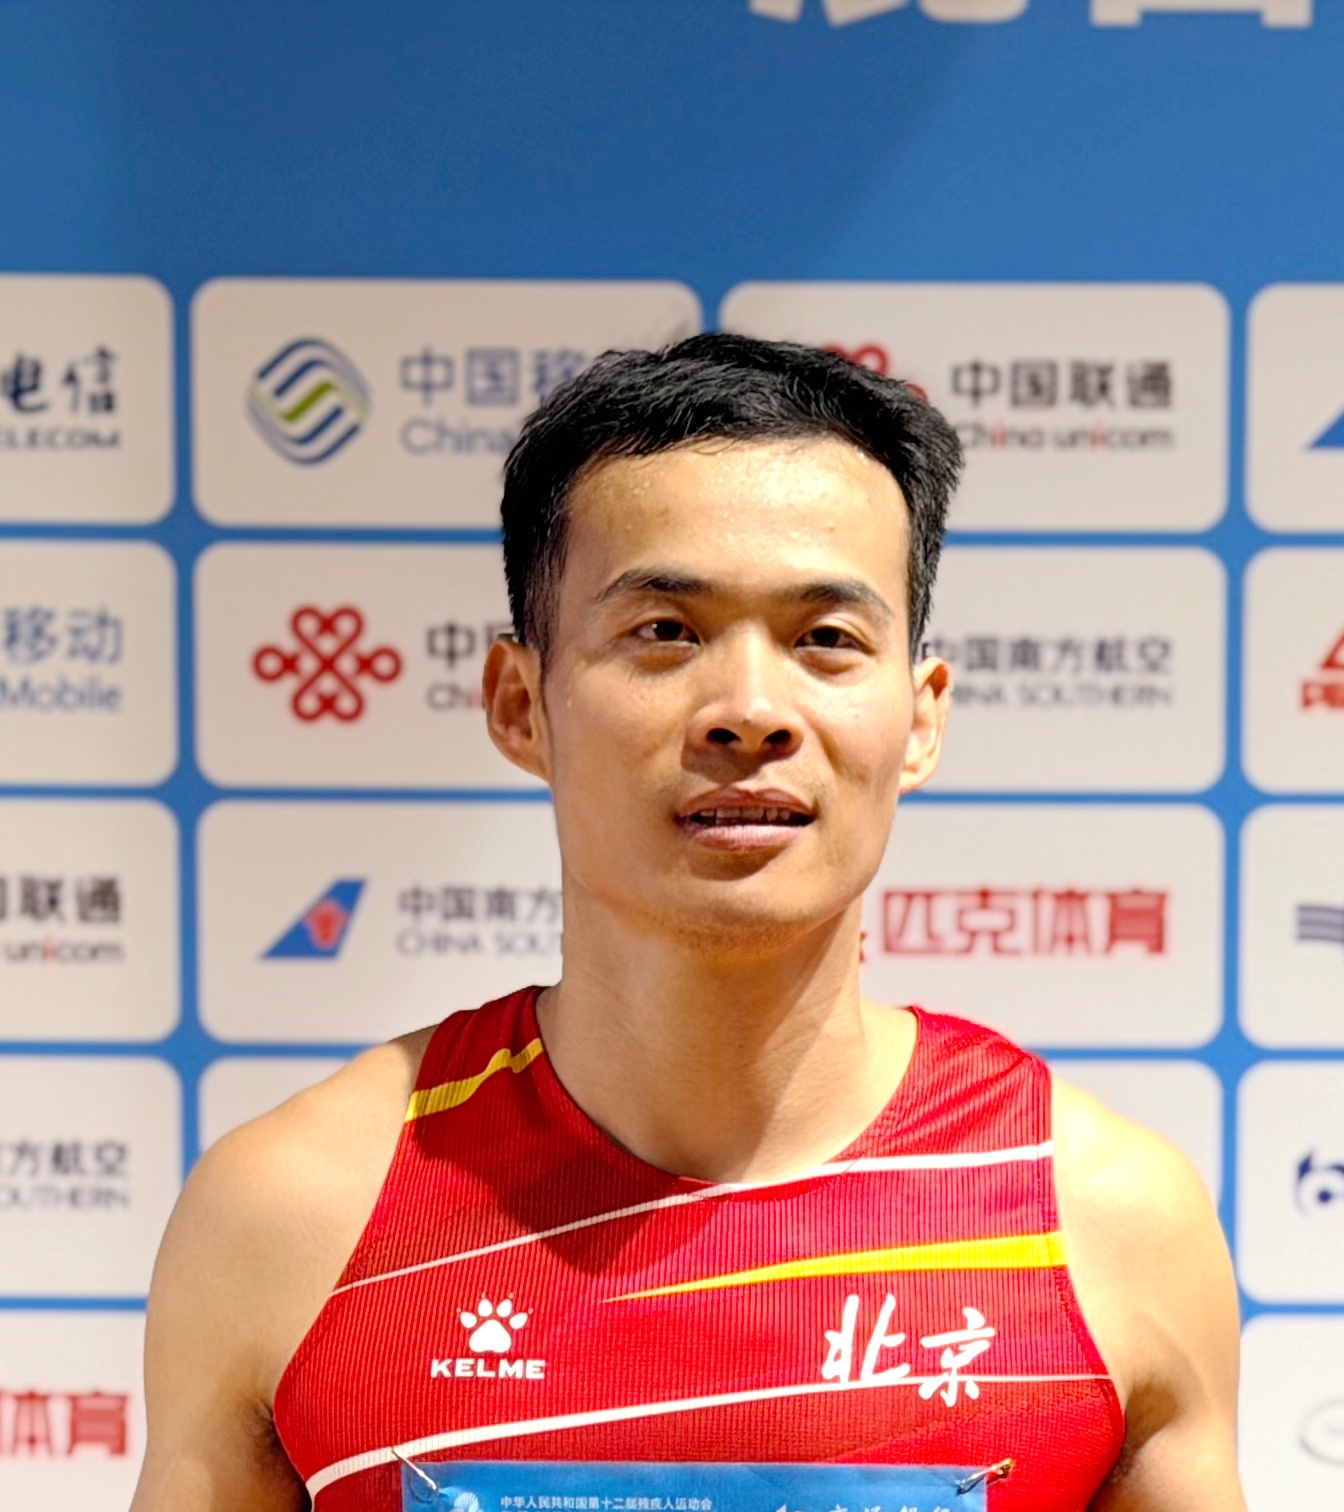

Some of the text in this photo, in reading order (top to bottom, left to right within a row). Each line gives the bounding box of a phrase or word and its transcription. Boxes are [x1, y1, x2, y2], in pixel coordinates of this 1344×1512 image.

[948, 360, 1172, 408] 中国联通
[397, 884, 561, 925] 中国南方
[880, 885, 1170, 954] 匹克体育
[431, 1358, 545, 1380] KELME
[822, 1294, 995, 1407] 北京
